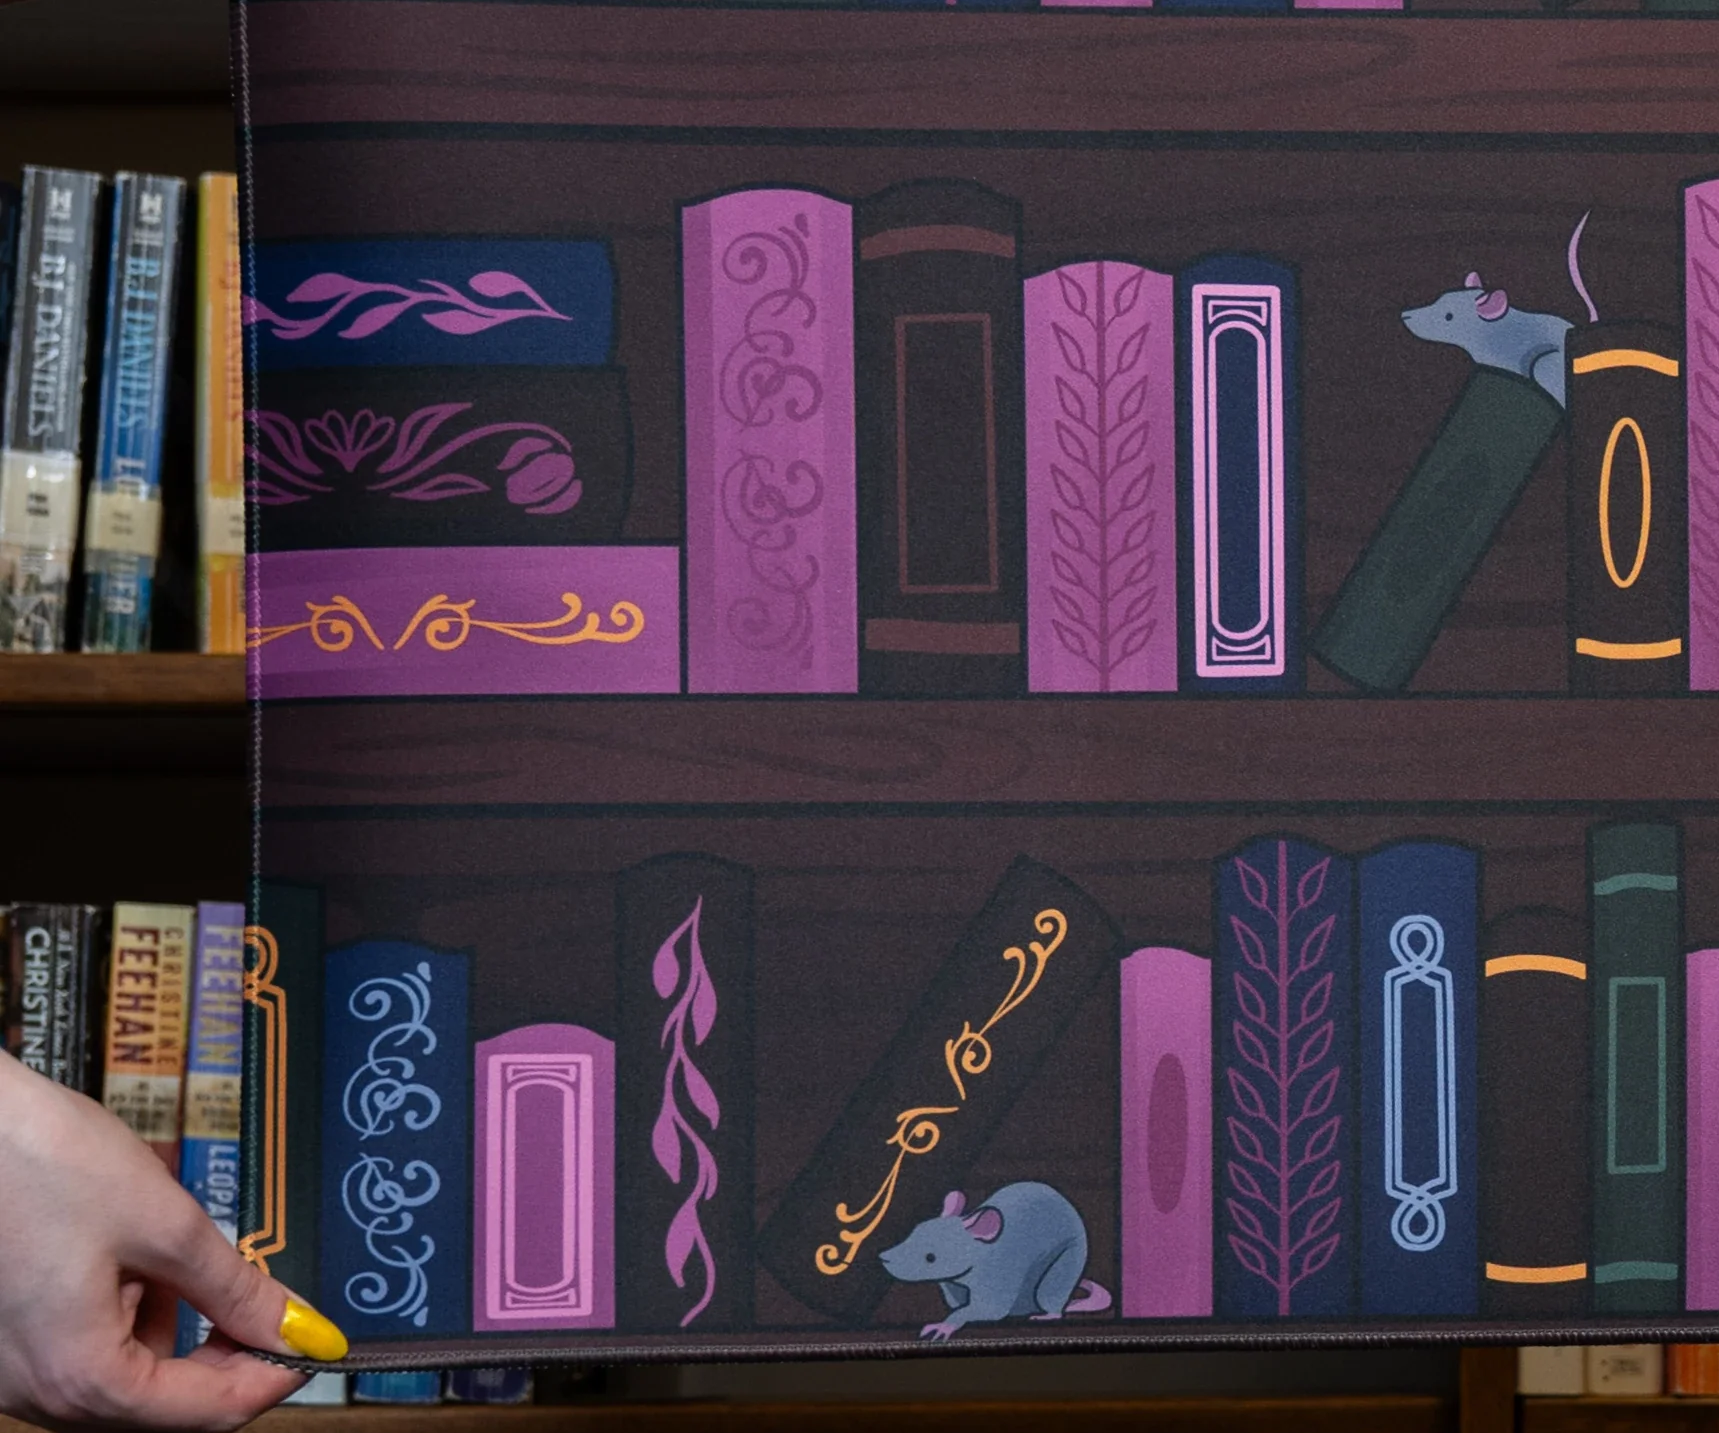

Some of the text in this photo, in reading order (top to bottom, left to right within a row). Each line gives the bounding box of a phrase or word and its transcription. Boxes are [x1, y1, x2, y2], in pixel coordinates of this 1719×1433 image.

[28, 304, 61, 436] DANIELS
[115, 311, 156, 428] DANIELS
[22, 927, 50, 1069] CHRISTINE
[113, 926, 159, 1064] FEEHAN
[157, 927, 183, 1066] CHRISTINE
[198, 924, 245, 1064] FEEHAN
